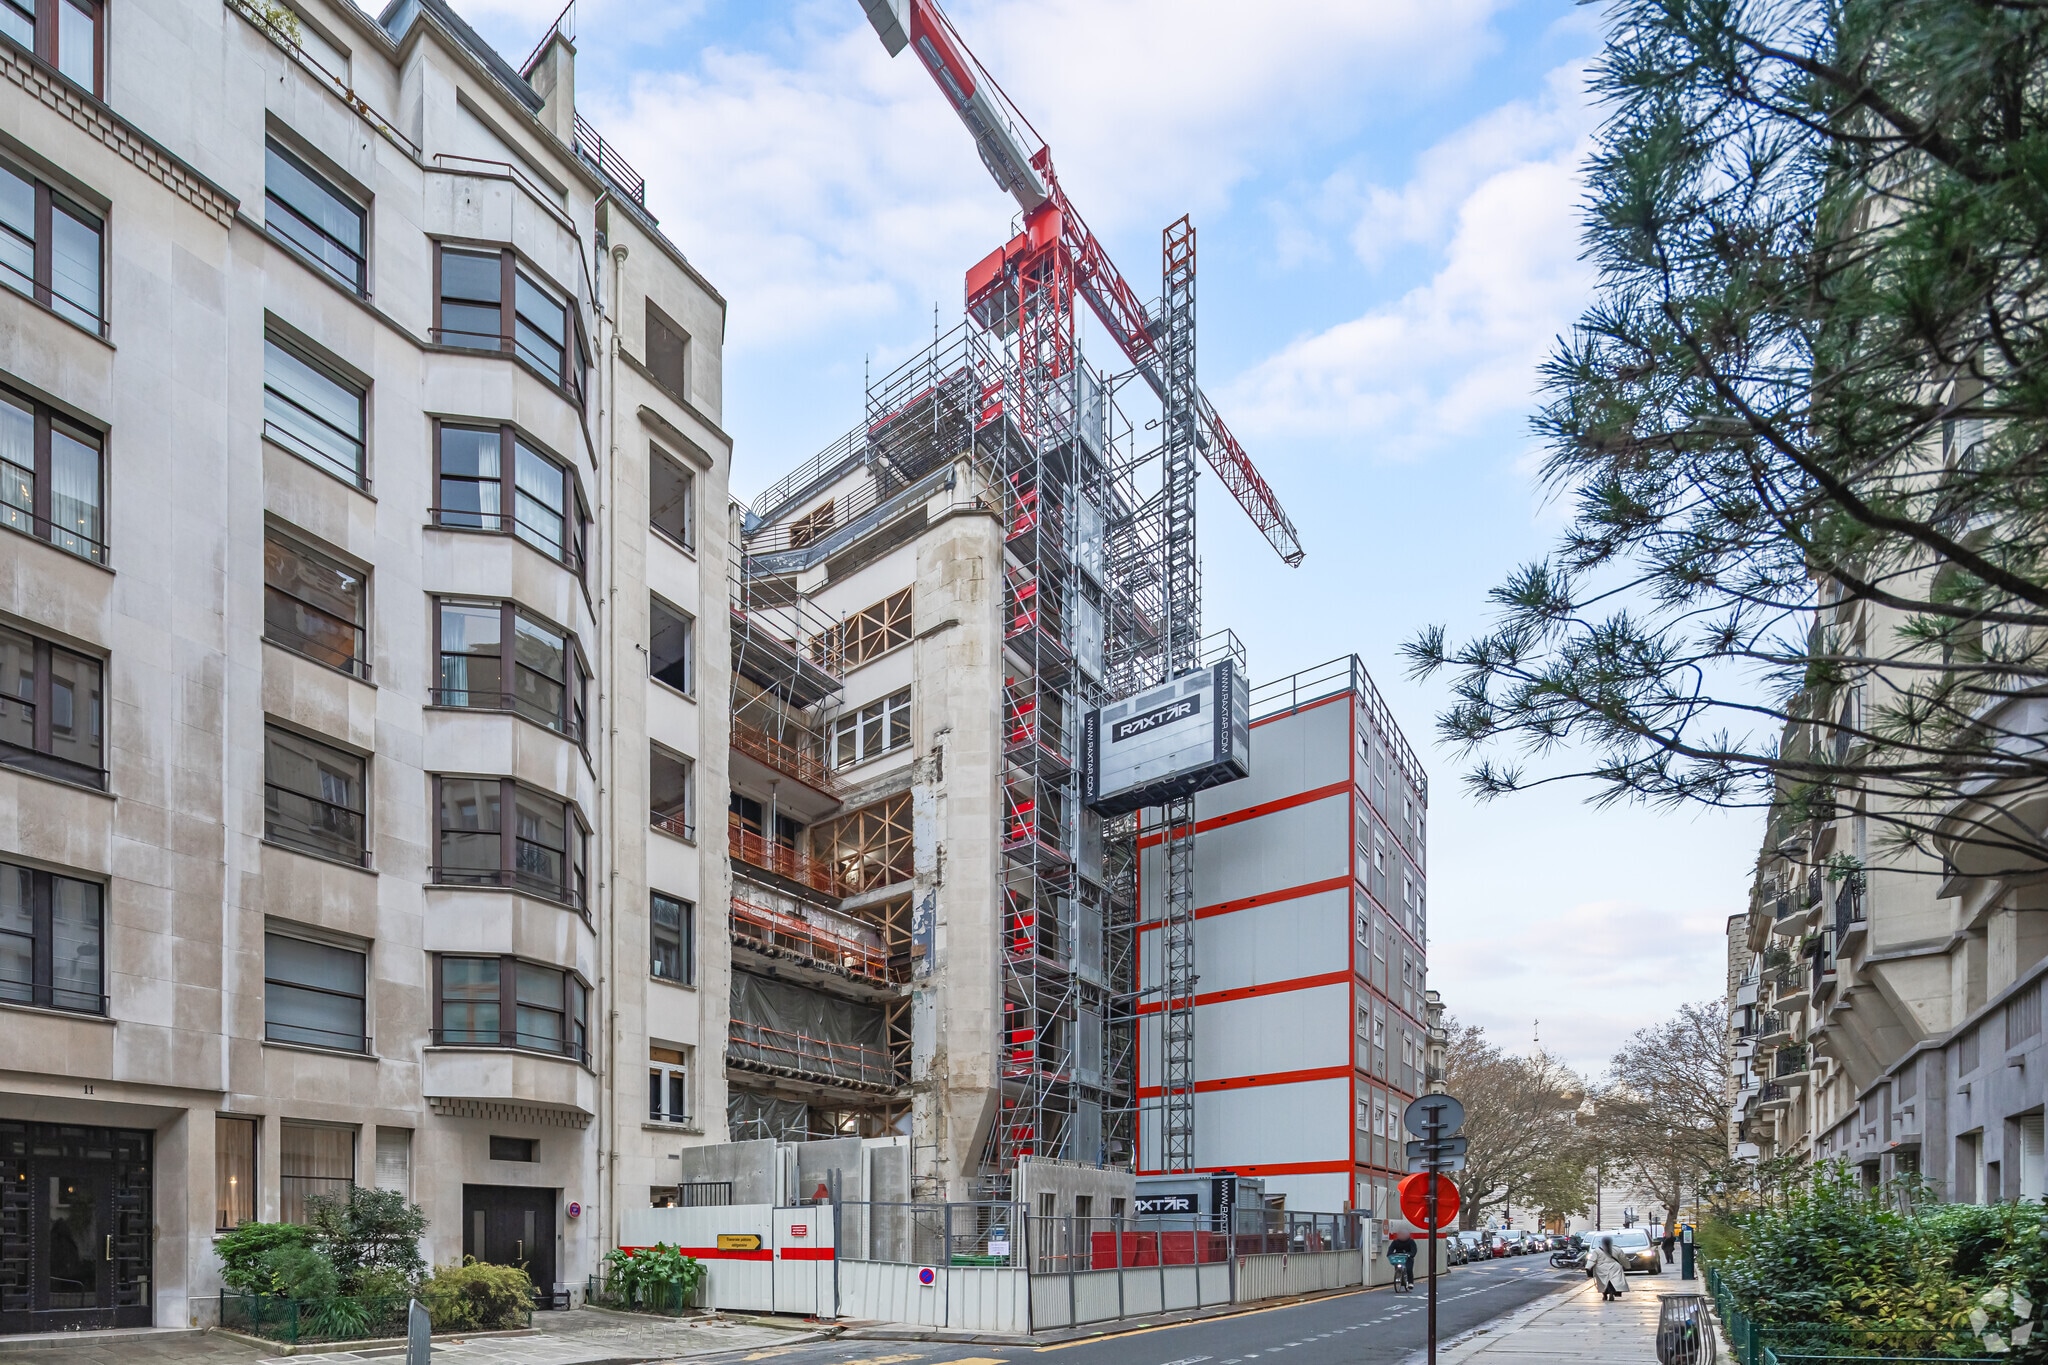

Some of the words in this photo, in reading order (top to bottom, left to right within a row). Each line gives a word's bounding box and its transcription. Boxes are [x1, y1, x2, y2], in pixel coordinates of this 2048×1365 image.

[1120, 702, 1191, 737] RAXTAR
[84, 1084, 94, 1095] 11
[1134, 1198, 1189, 1211] AXTAR
